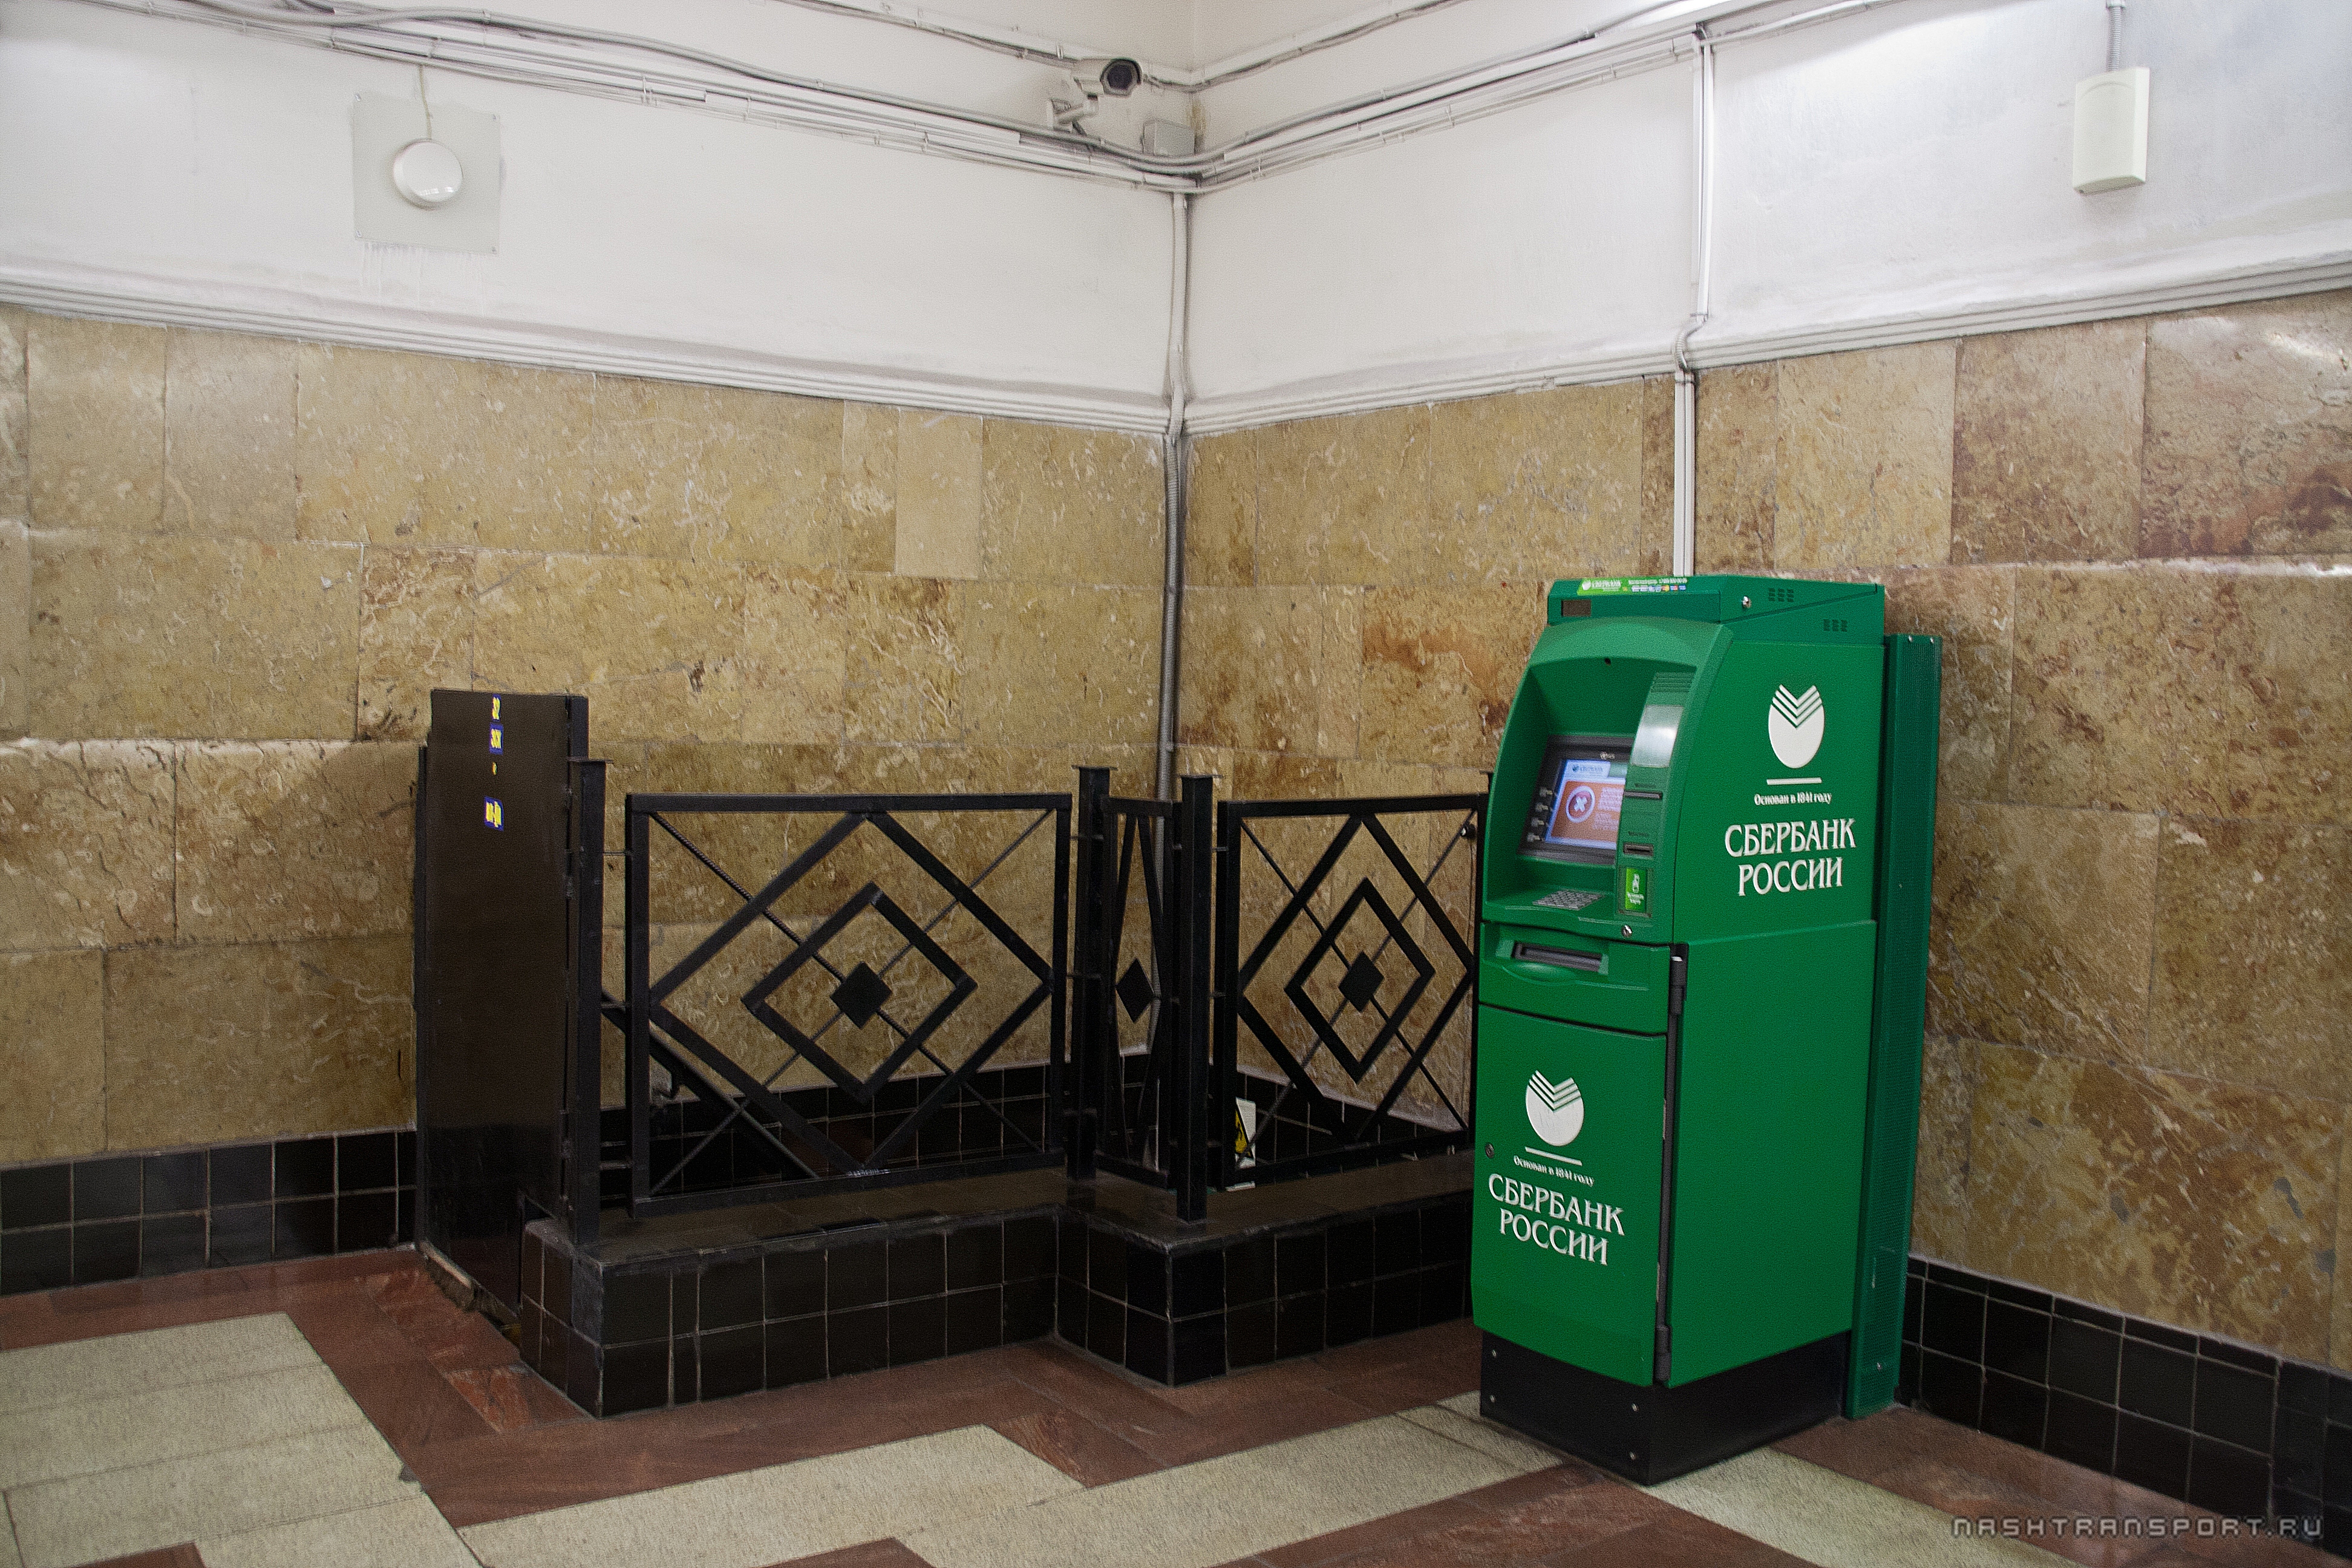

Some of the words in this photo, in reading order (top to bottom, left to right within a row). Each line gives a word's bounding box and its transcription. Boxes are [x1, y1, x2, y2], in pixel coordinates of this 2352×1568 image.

[1754, 793, 1789, 805] Основан
[1790, 794, 1796, 803] в
[1797, 791, 1813, 803] 1841
[1814, 792, 1832, 804] году
[1725, 818, 1857, 857] СБЕРБАНК
[1738, 857, 1843, 896] РОССИИ
[1514, 1155, 1547, 1174] Основан
[1548, 1166, 1555, 1175] в
[1555, 1166, 1573, 1180] 1841
[1573, 1172, 1595, 1187] году
[1489, 1173, 1624, 1235] СБЕРБАНК
[1500, 1207, 1608, 1266] РОССИИ
